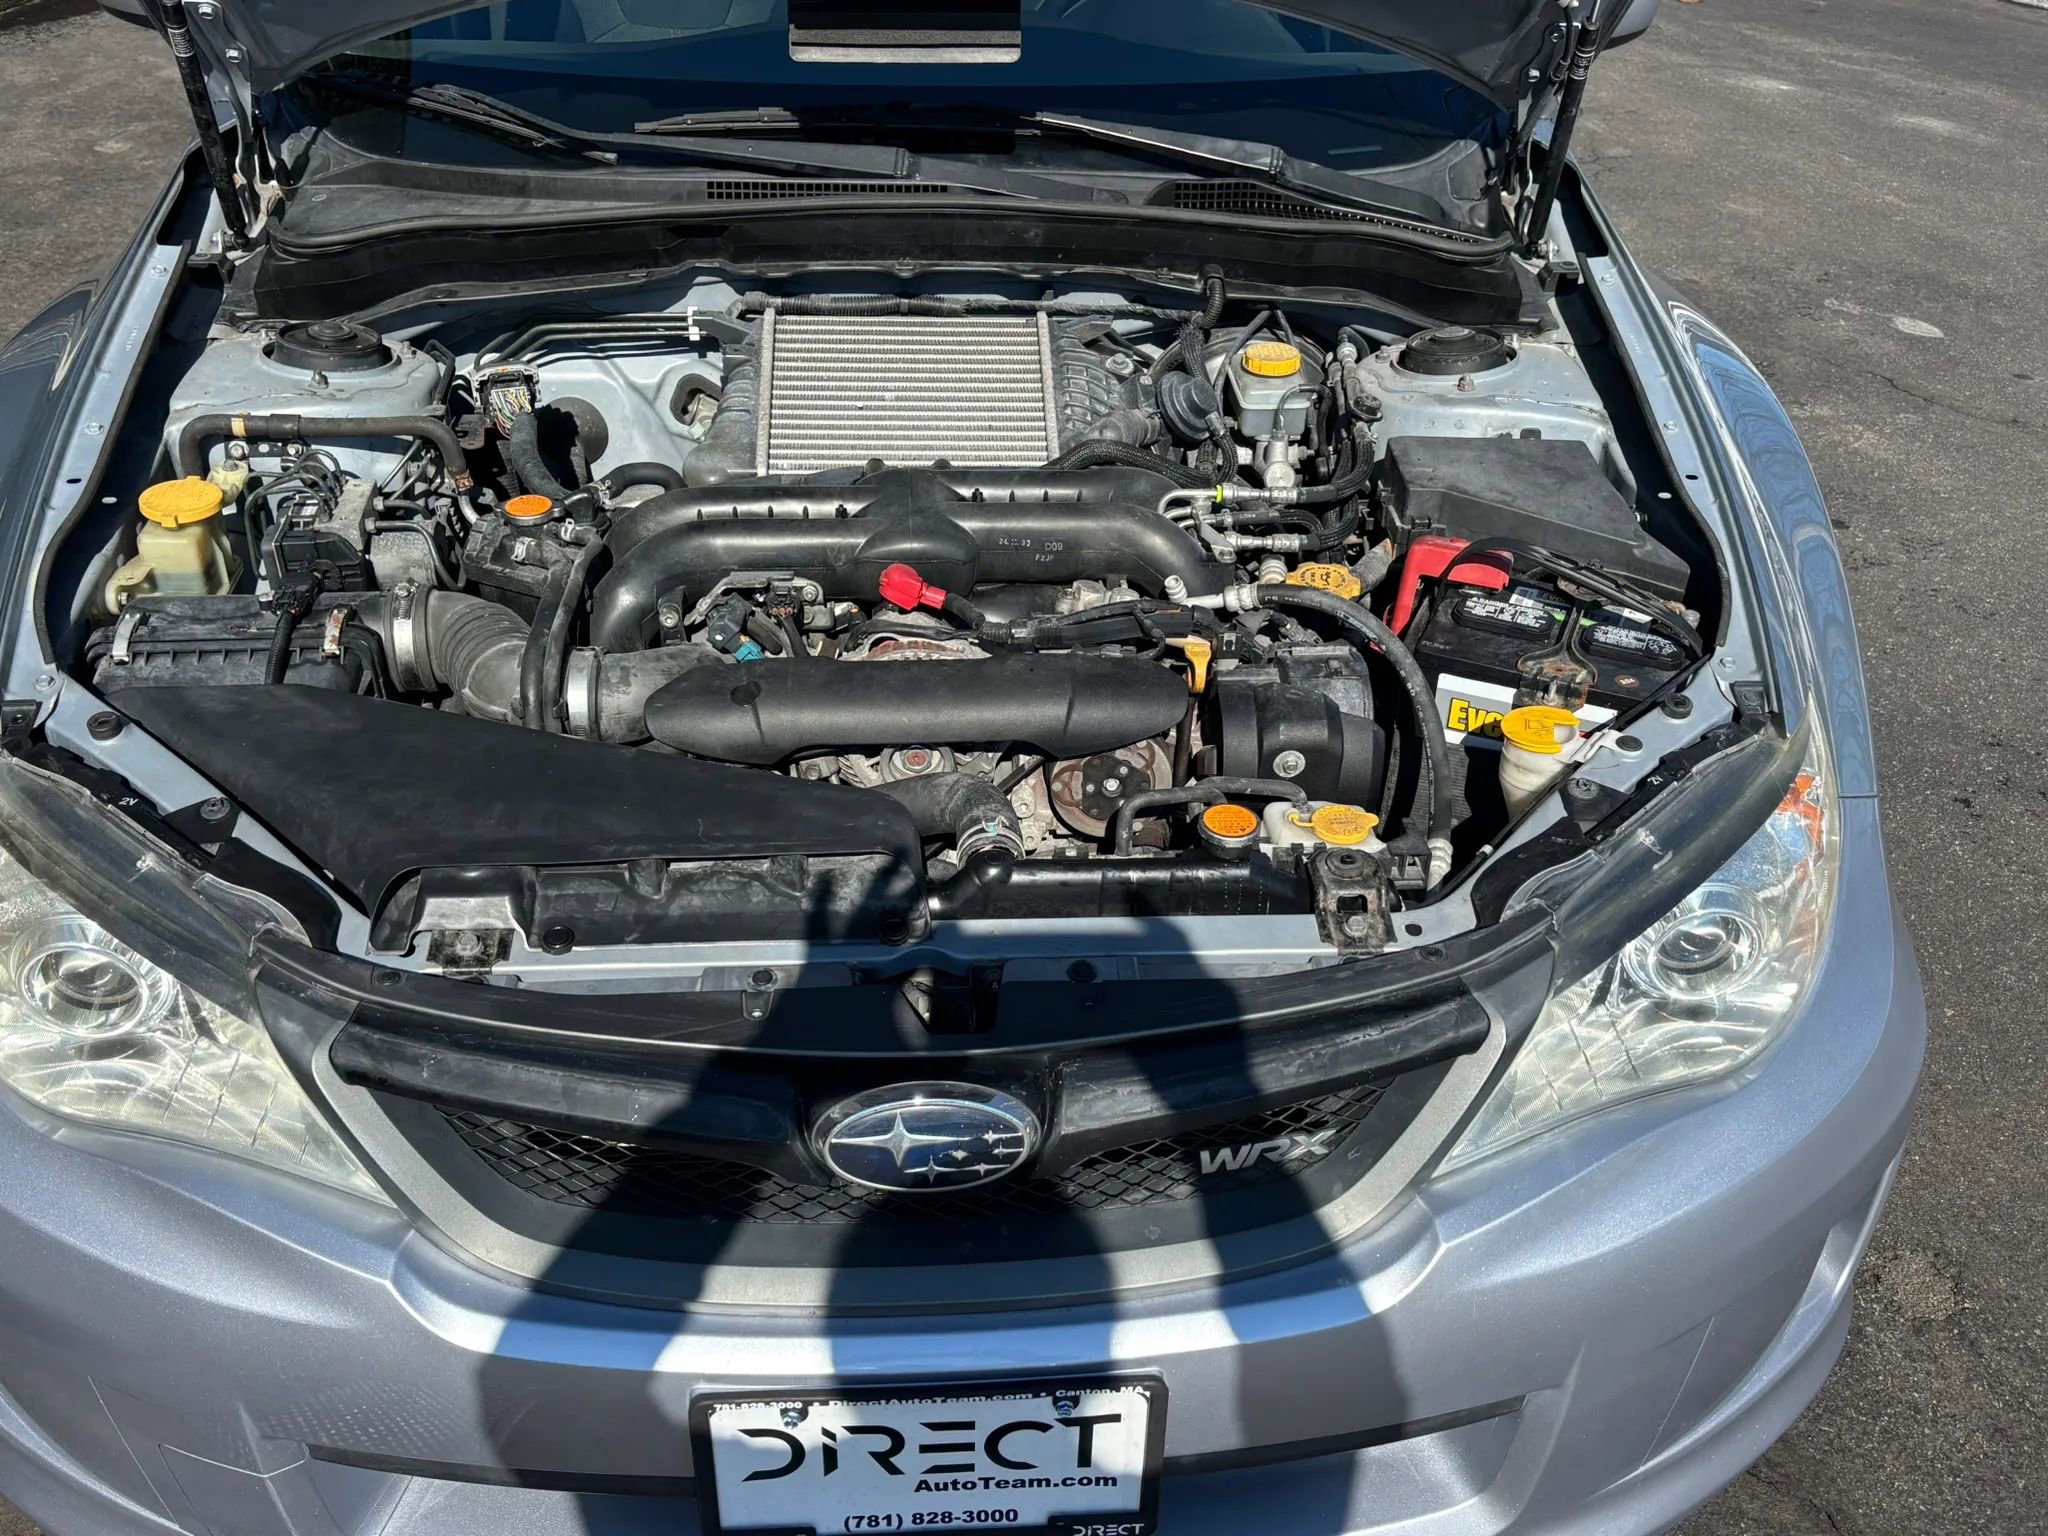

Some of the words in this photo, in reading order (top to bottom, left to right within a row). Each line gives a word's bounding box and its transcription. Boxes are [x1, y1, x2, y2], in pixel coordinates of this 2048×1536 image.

[1200, 1129, 1337, 1175] WRX
[736, 1413, 1122, 1482] DIRECT
[913, 1475, 1118, 1493] AutoTeam.com
[843, 1513, 904, 1533] (781)
[911, 1508, 1019, 1526] 828-3000
